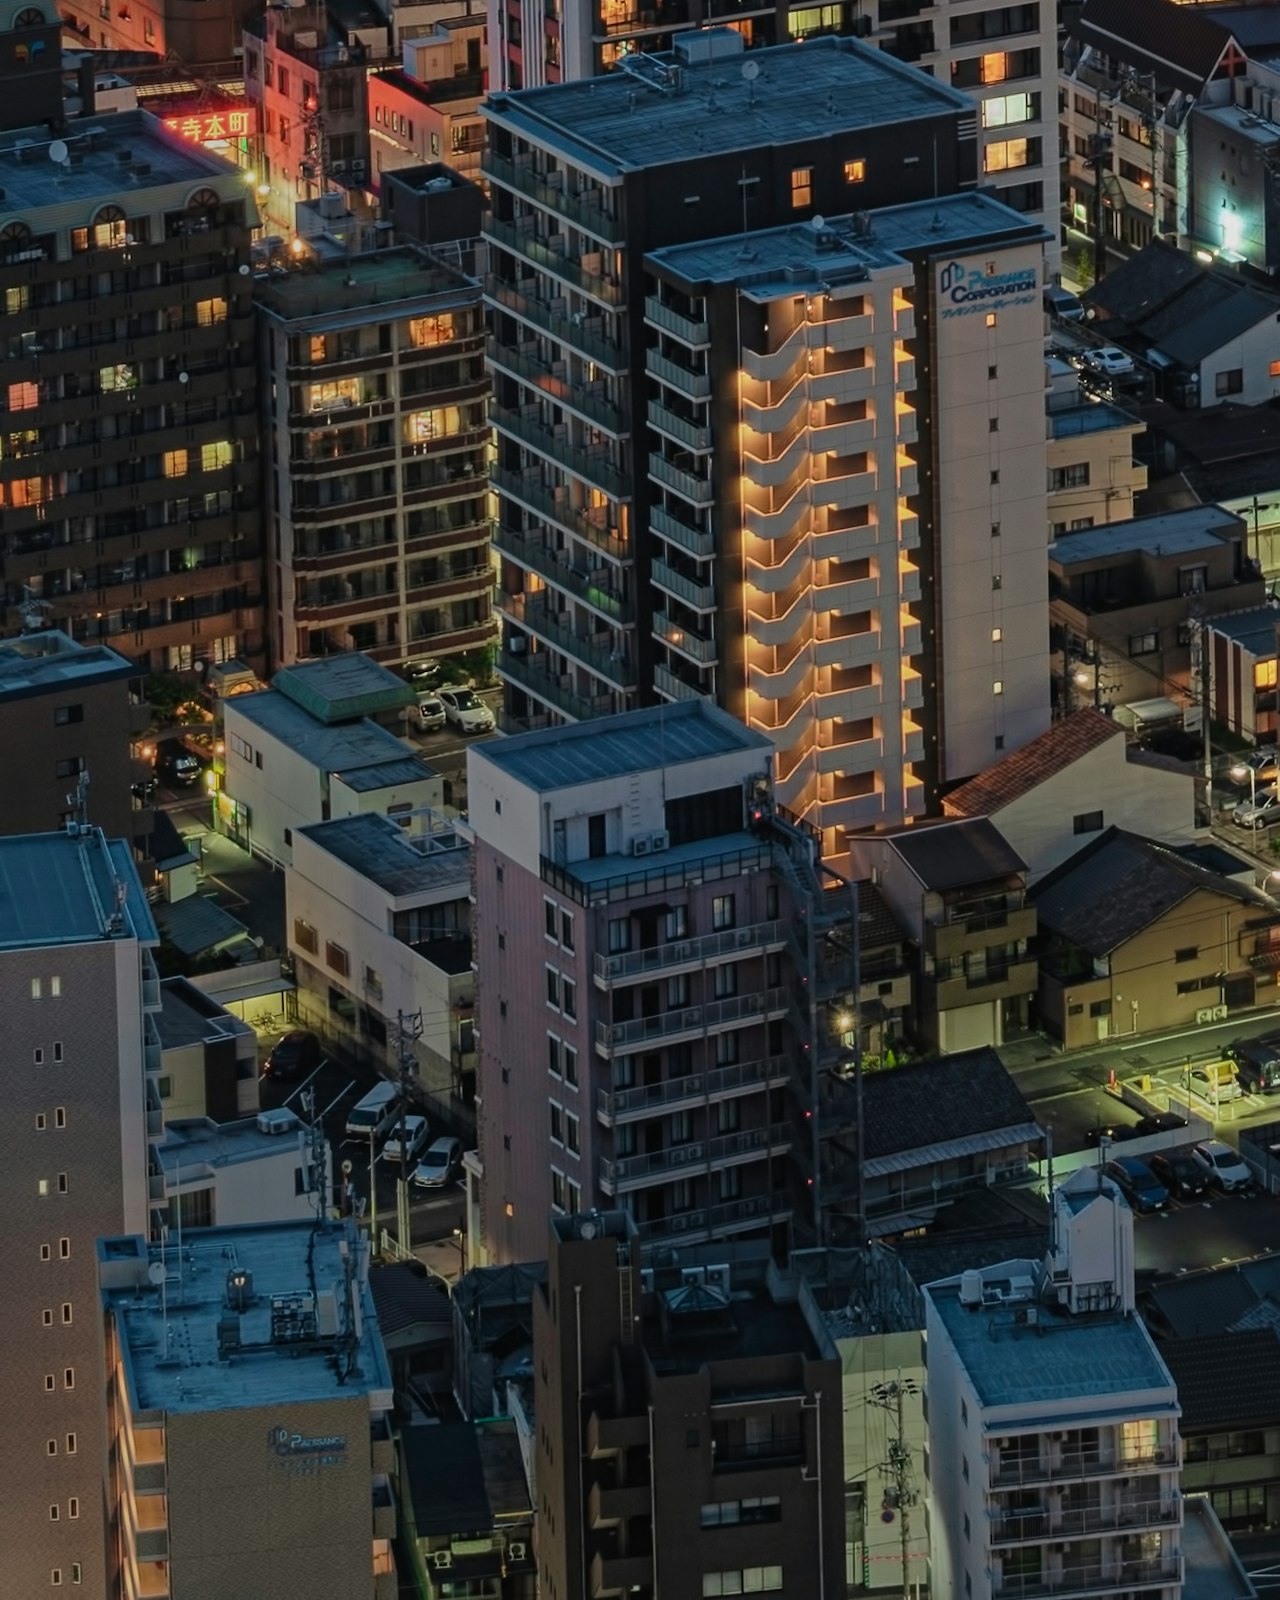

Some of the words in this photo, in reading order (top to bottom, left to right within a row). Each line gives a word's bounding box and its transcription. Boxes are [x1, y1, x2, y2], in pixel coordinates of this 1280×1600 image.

[166, 111, 249, 142] 寺本町
[951, 280, 1037, 303] CORPORATION
